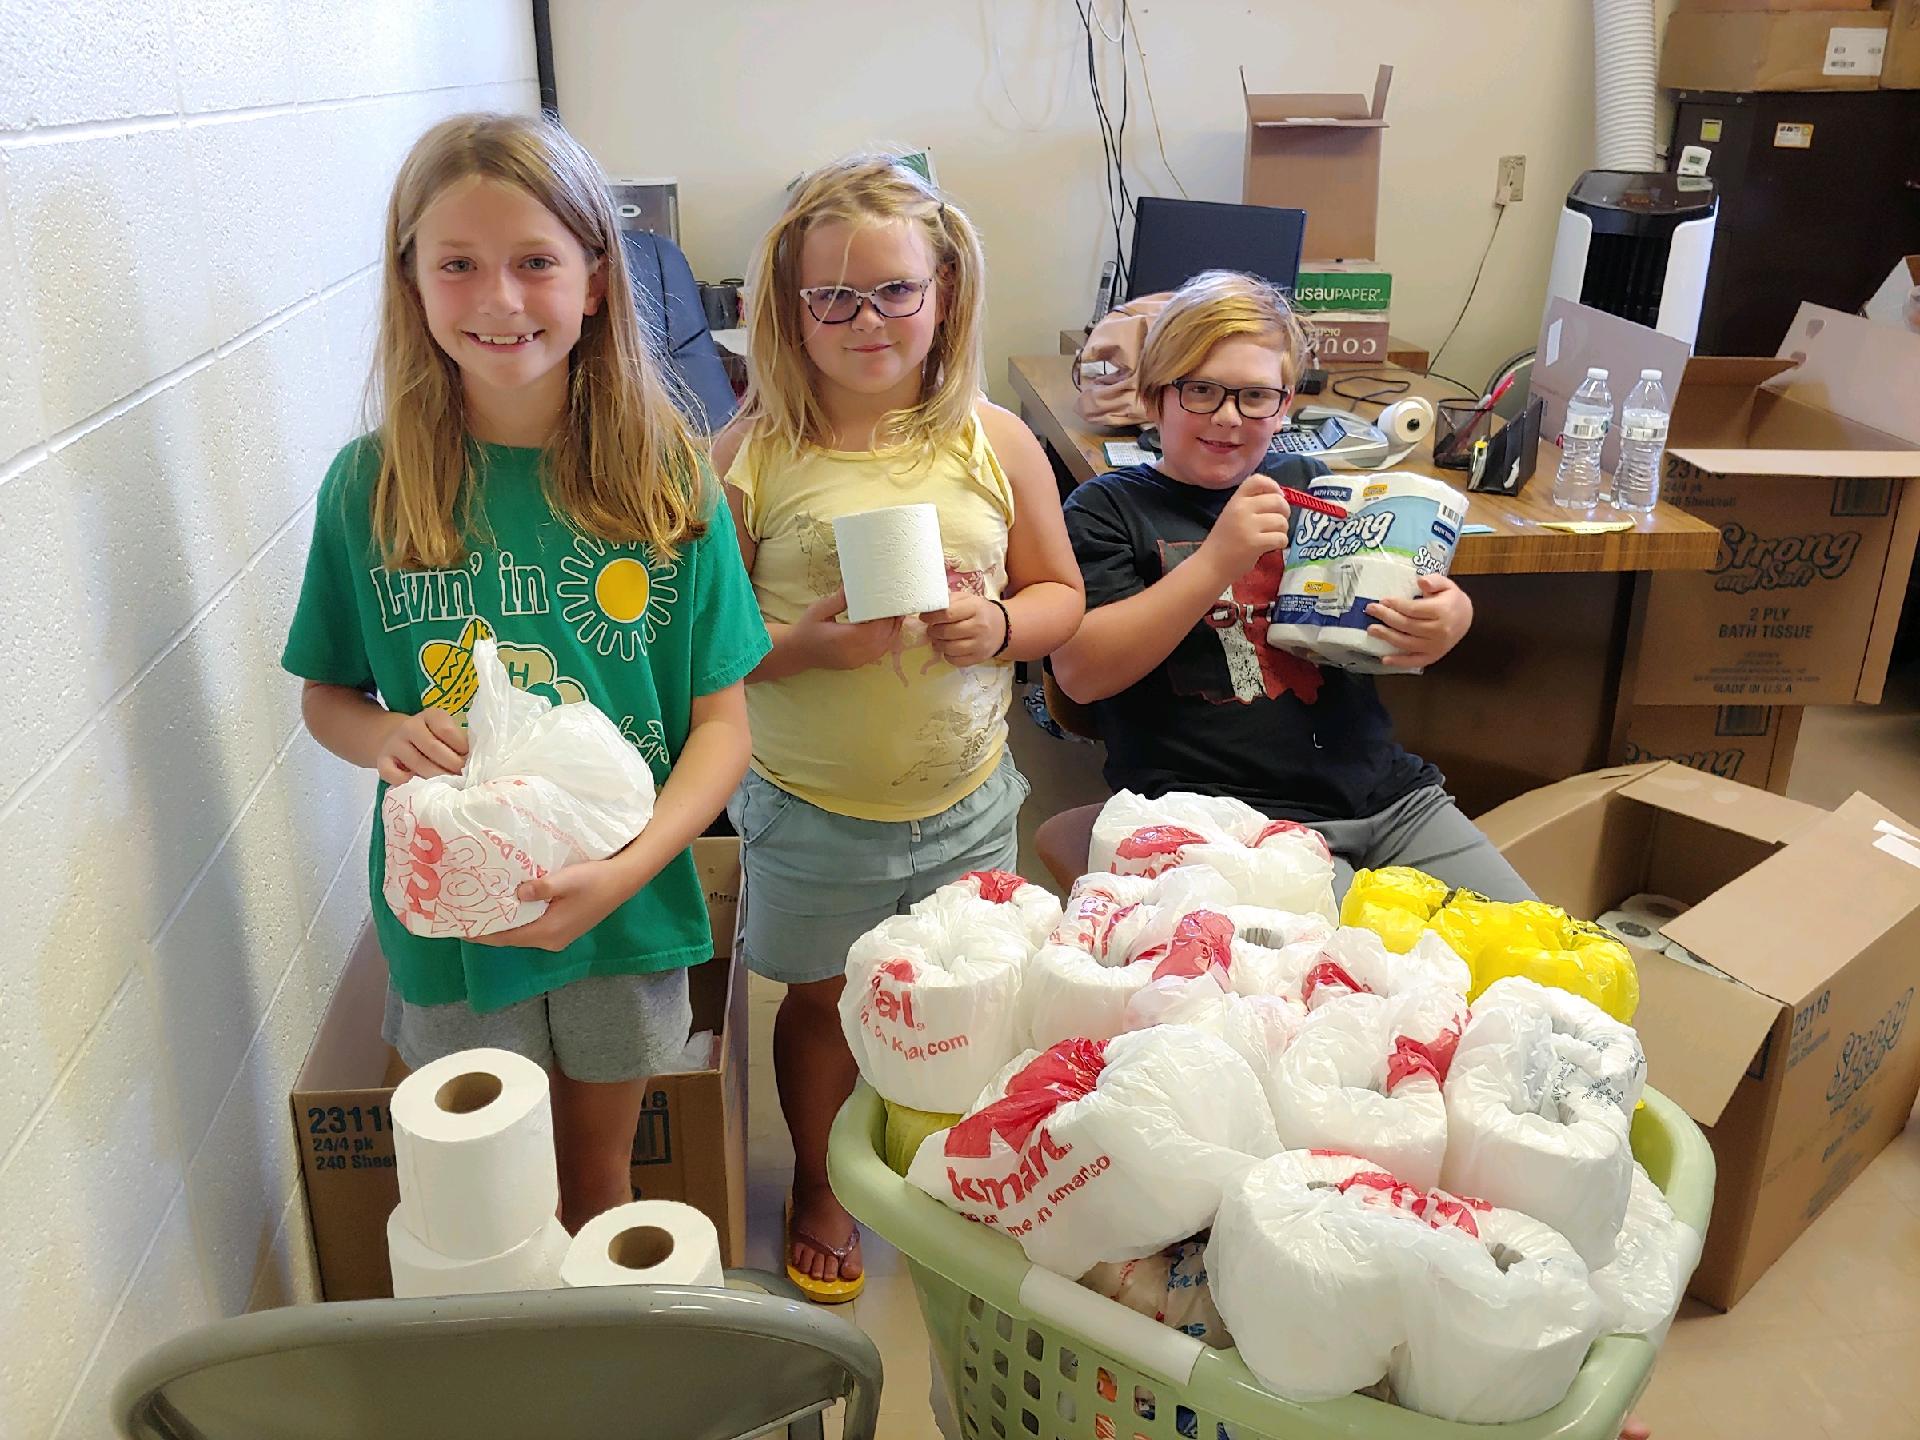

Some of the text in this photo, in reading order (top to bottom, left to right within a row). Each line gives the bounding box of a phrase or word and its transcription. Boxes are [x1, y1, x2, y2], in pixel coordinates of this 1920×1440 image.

[1294, 288, 1377, 302] usauPAPER
[1322, 338, 1377, 355] COU
[1666, 458, 1726, 480] 231
[1296, 509, 1395, 549] Strong
[1299, 537, 1362, 561] and Soft
[1705, 522, 1863, 579] Strong
[1413, 546, 1447, 576] Stron
[499, 551, 550, 616] in
[1750, 607, 1790, 621] 2 PLY
[1718, 624, 1814, 639] BATH TISSUE
[509, 661, 529, 688] H
[313, 1136, 374, 1153] 24/4 pk
[316, 1153, 396, 1170] 240 Shee
